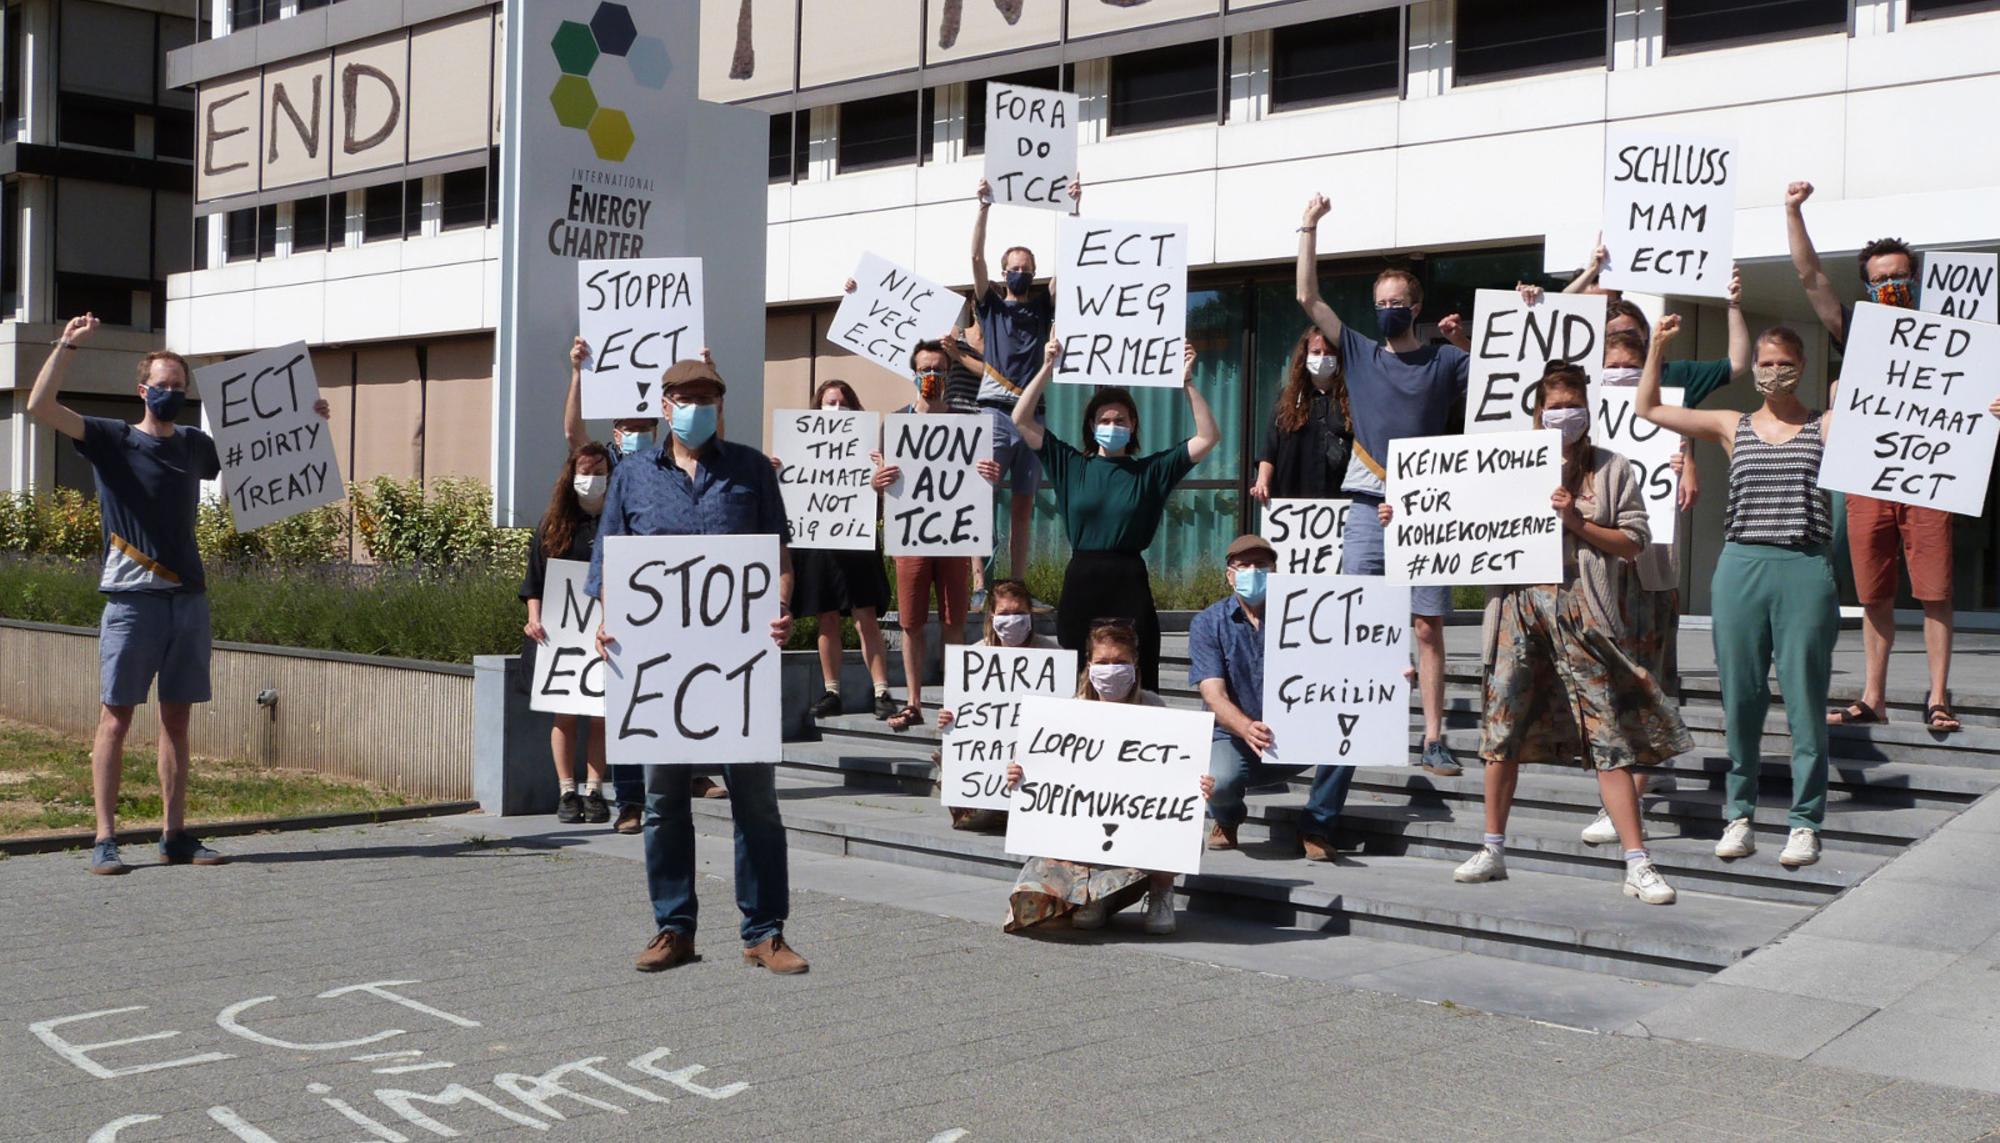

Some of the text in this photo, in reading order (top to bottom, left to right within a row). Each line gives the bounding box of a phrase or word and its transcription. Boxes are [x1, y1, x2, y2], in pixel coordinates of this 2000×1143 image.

[204, 63, 400, 176] END
[996, 90, 1065, 128] FORA
[572, 168, 655, 191] INTERNATIONAL
[1614, 144, 1730, 186] SCHLUSS
[997, 172, 1068, 203] TCE
[568, 184, 651, 230] ENERGY
[1629, 201, 1707, 233] MAM
[548, 218, 644, 259] CHARTER
[1077, 229, 1175, 266] ECT
[1630, 247, 1708, 281] ECT!
[1927, 263, 1993, 296] NON
[586, 270, 691, 311] STOPPA
[1076, 283, 1171, 326] WEG
[1940, 296, 1979, 320] AU
[595, 326, 688, 373] ECT
[843, 323, 906, 366] E.C.T.
[1058, 334, 1181, 376] ERMEE
[1479, 309, 1595, 363] END
[1890, 317, 1971, 358] RED
[222, 354, 304, 428] ECT
[1887, 360, 1965, 395] HET
[796, 415, 856, 435] SAVE
[1850, 387, 1983, 435] KLIMAAT
[806, 438, 859, 460] THE
[896, 424, 983, 465] NON
[1397, 445, 1548, 480] KEINE KOHLE
[1874, 432, 1951, 465] STOP
[234, 461, 327, 511] TREATY
[779, 465, 872, 487] CLIMATE
[911, 466, 964, 502] AU
[1871, 467, 1956, 500] ECT
[807, 493, 858, 513] NOT
[1401, 487, 1451, 516] FÜR
[895, 505, 979, 546] T.C.E.
[1398, 515, 1556, 547] KOHLEKONZERNE
[1407, 550, 1525, 580] #NO ECT
[626, 555, 771, 633] STOP
[962, 650, 1056, 692] PARA
[618, 649, 767, 740] ECT
[1029, 726, 1191, 764] LOPPU ECT-
[30, 979, 481, 1078] ECT
